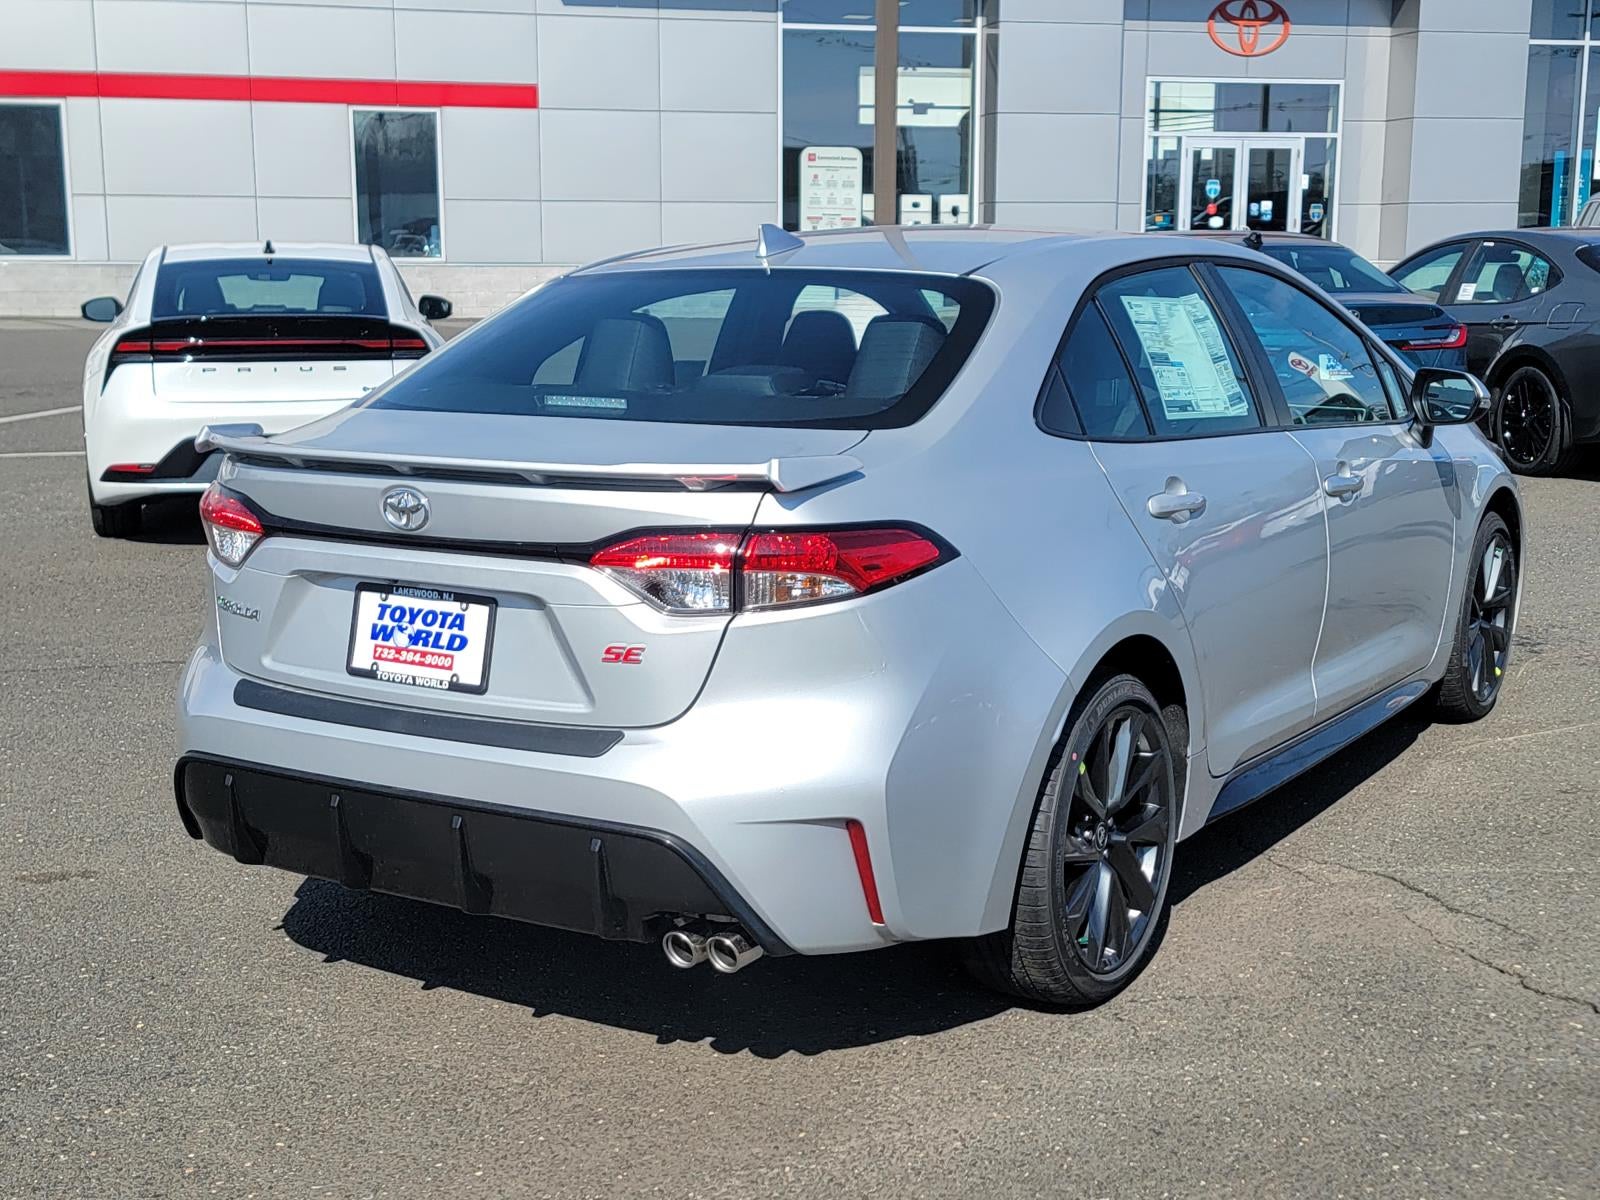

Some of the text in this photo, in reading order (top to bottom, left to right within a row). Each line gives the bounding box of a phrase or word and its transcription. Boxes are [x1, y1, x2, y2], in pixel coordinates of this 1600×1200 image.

[443, 592, 455, 601] NJ
[377, 603, 466, 631] TOYOTA
[374, 647, 452, 668] 732-364-9000
[601, 645, 647, 665] SE
[376, 671, 449, 689] TOYOTA WORLD
